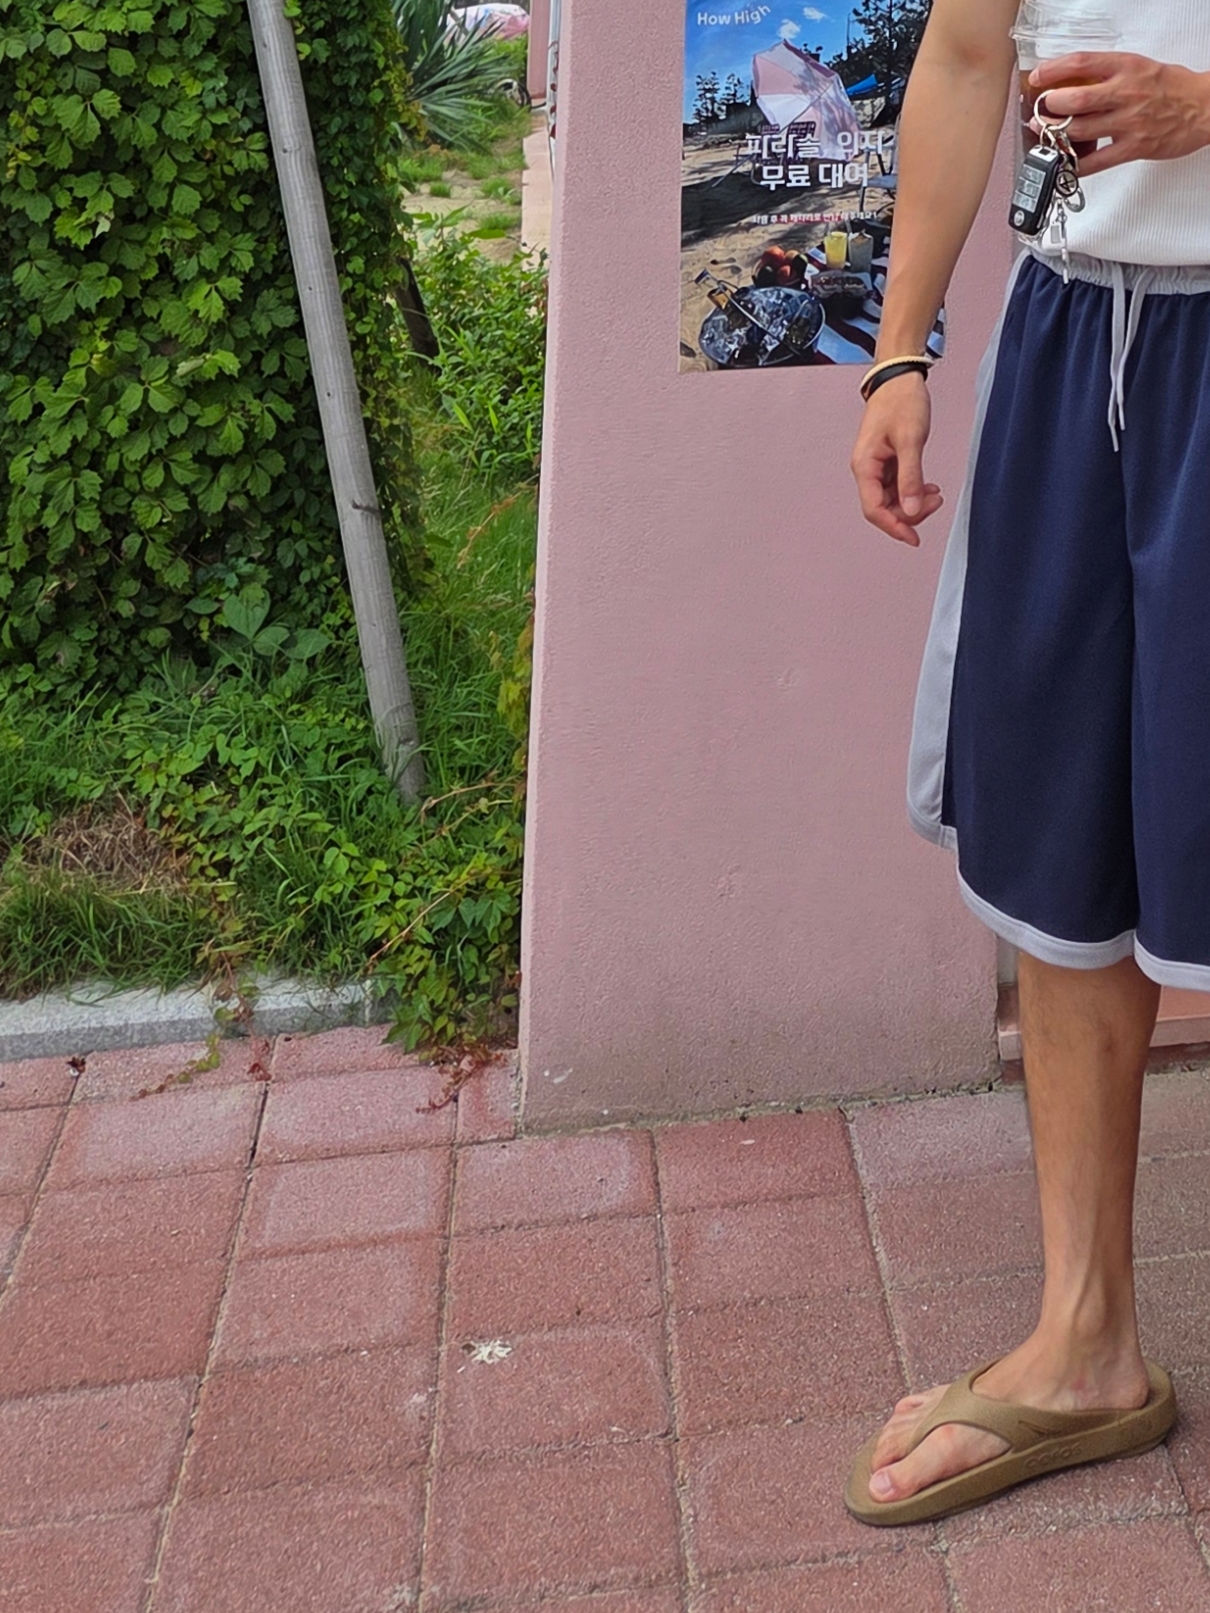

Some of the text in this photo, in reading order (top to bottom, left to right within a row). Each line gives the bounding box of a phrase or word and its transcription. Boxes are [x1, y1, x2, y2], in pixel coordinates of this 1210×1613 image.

[697, 3, 772, 26] How High
[760, 162, 868, 191] 무료 대여
